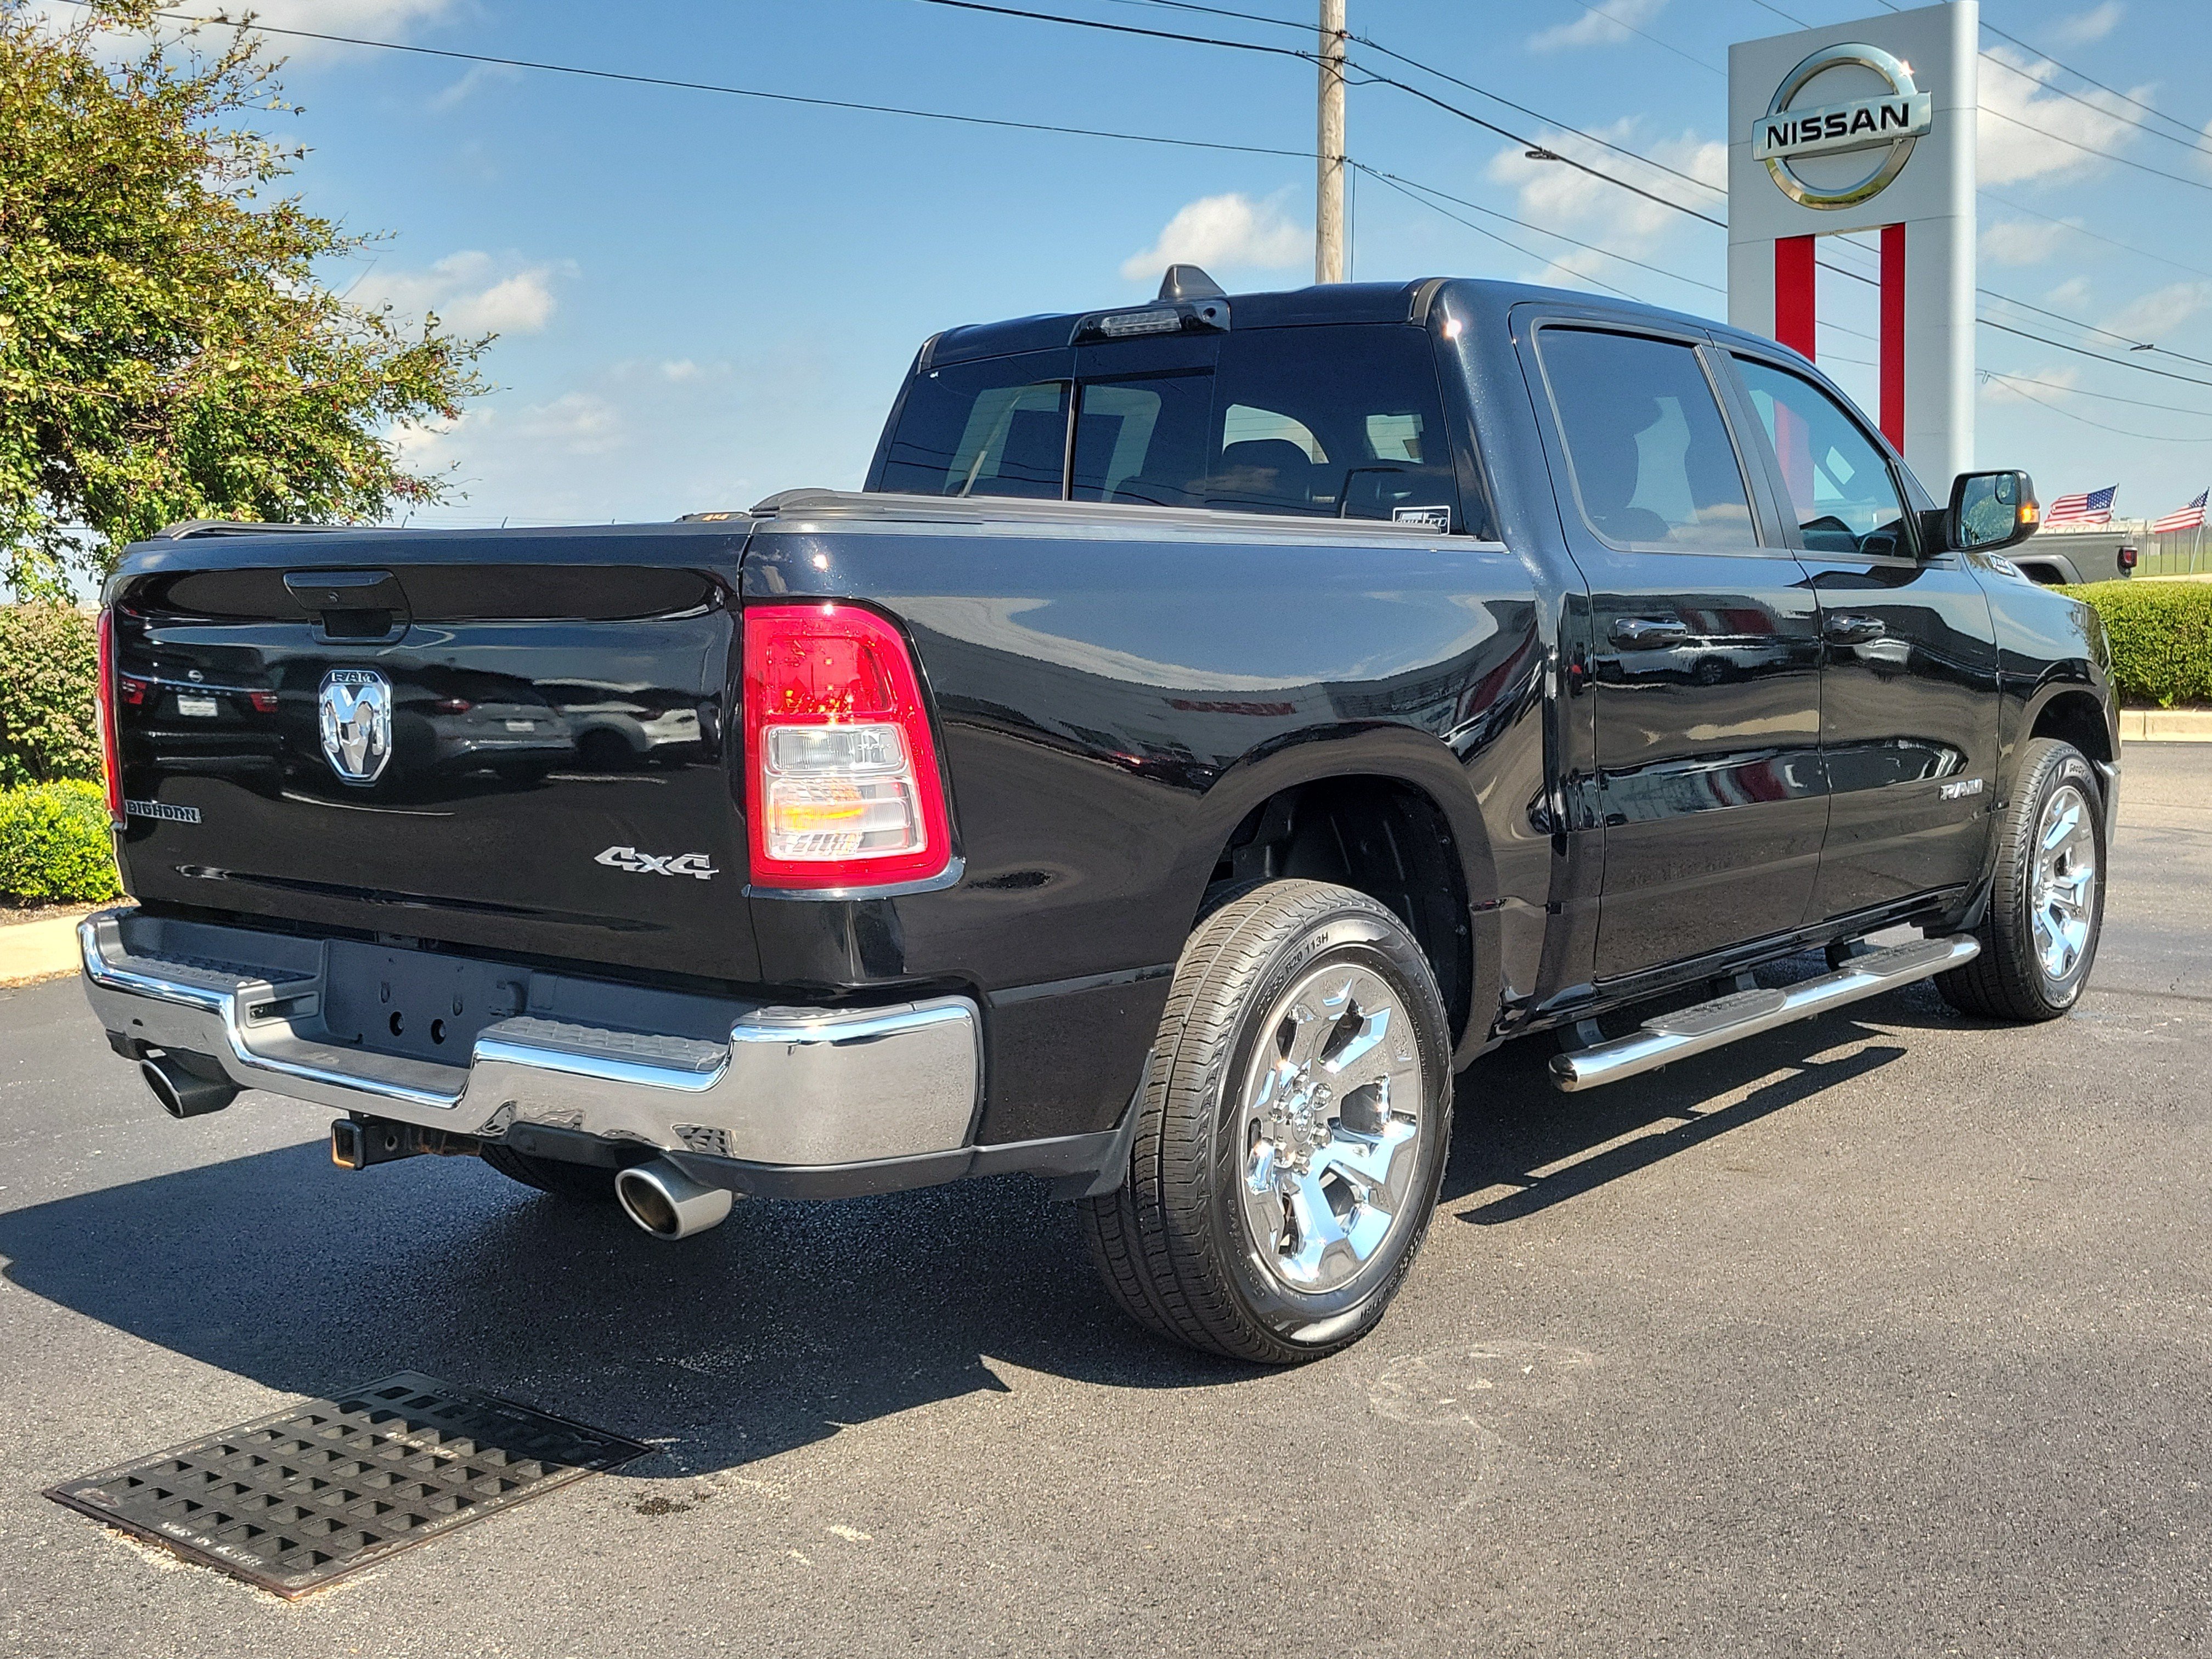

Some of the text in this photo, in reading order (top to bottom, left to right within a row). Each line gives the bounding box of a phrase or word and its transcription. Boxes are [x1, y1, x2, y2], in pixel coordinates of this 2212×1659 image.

[1766, 103, 1910, 149] NISSAN
[331, 672, 375, 683] RAM
[1939, 778, 1983, 801] RAM
[1284, 951, 1304, 974] R20
[1305, 932, 1329, 955] 113H
